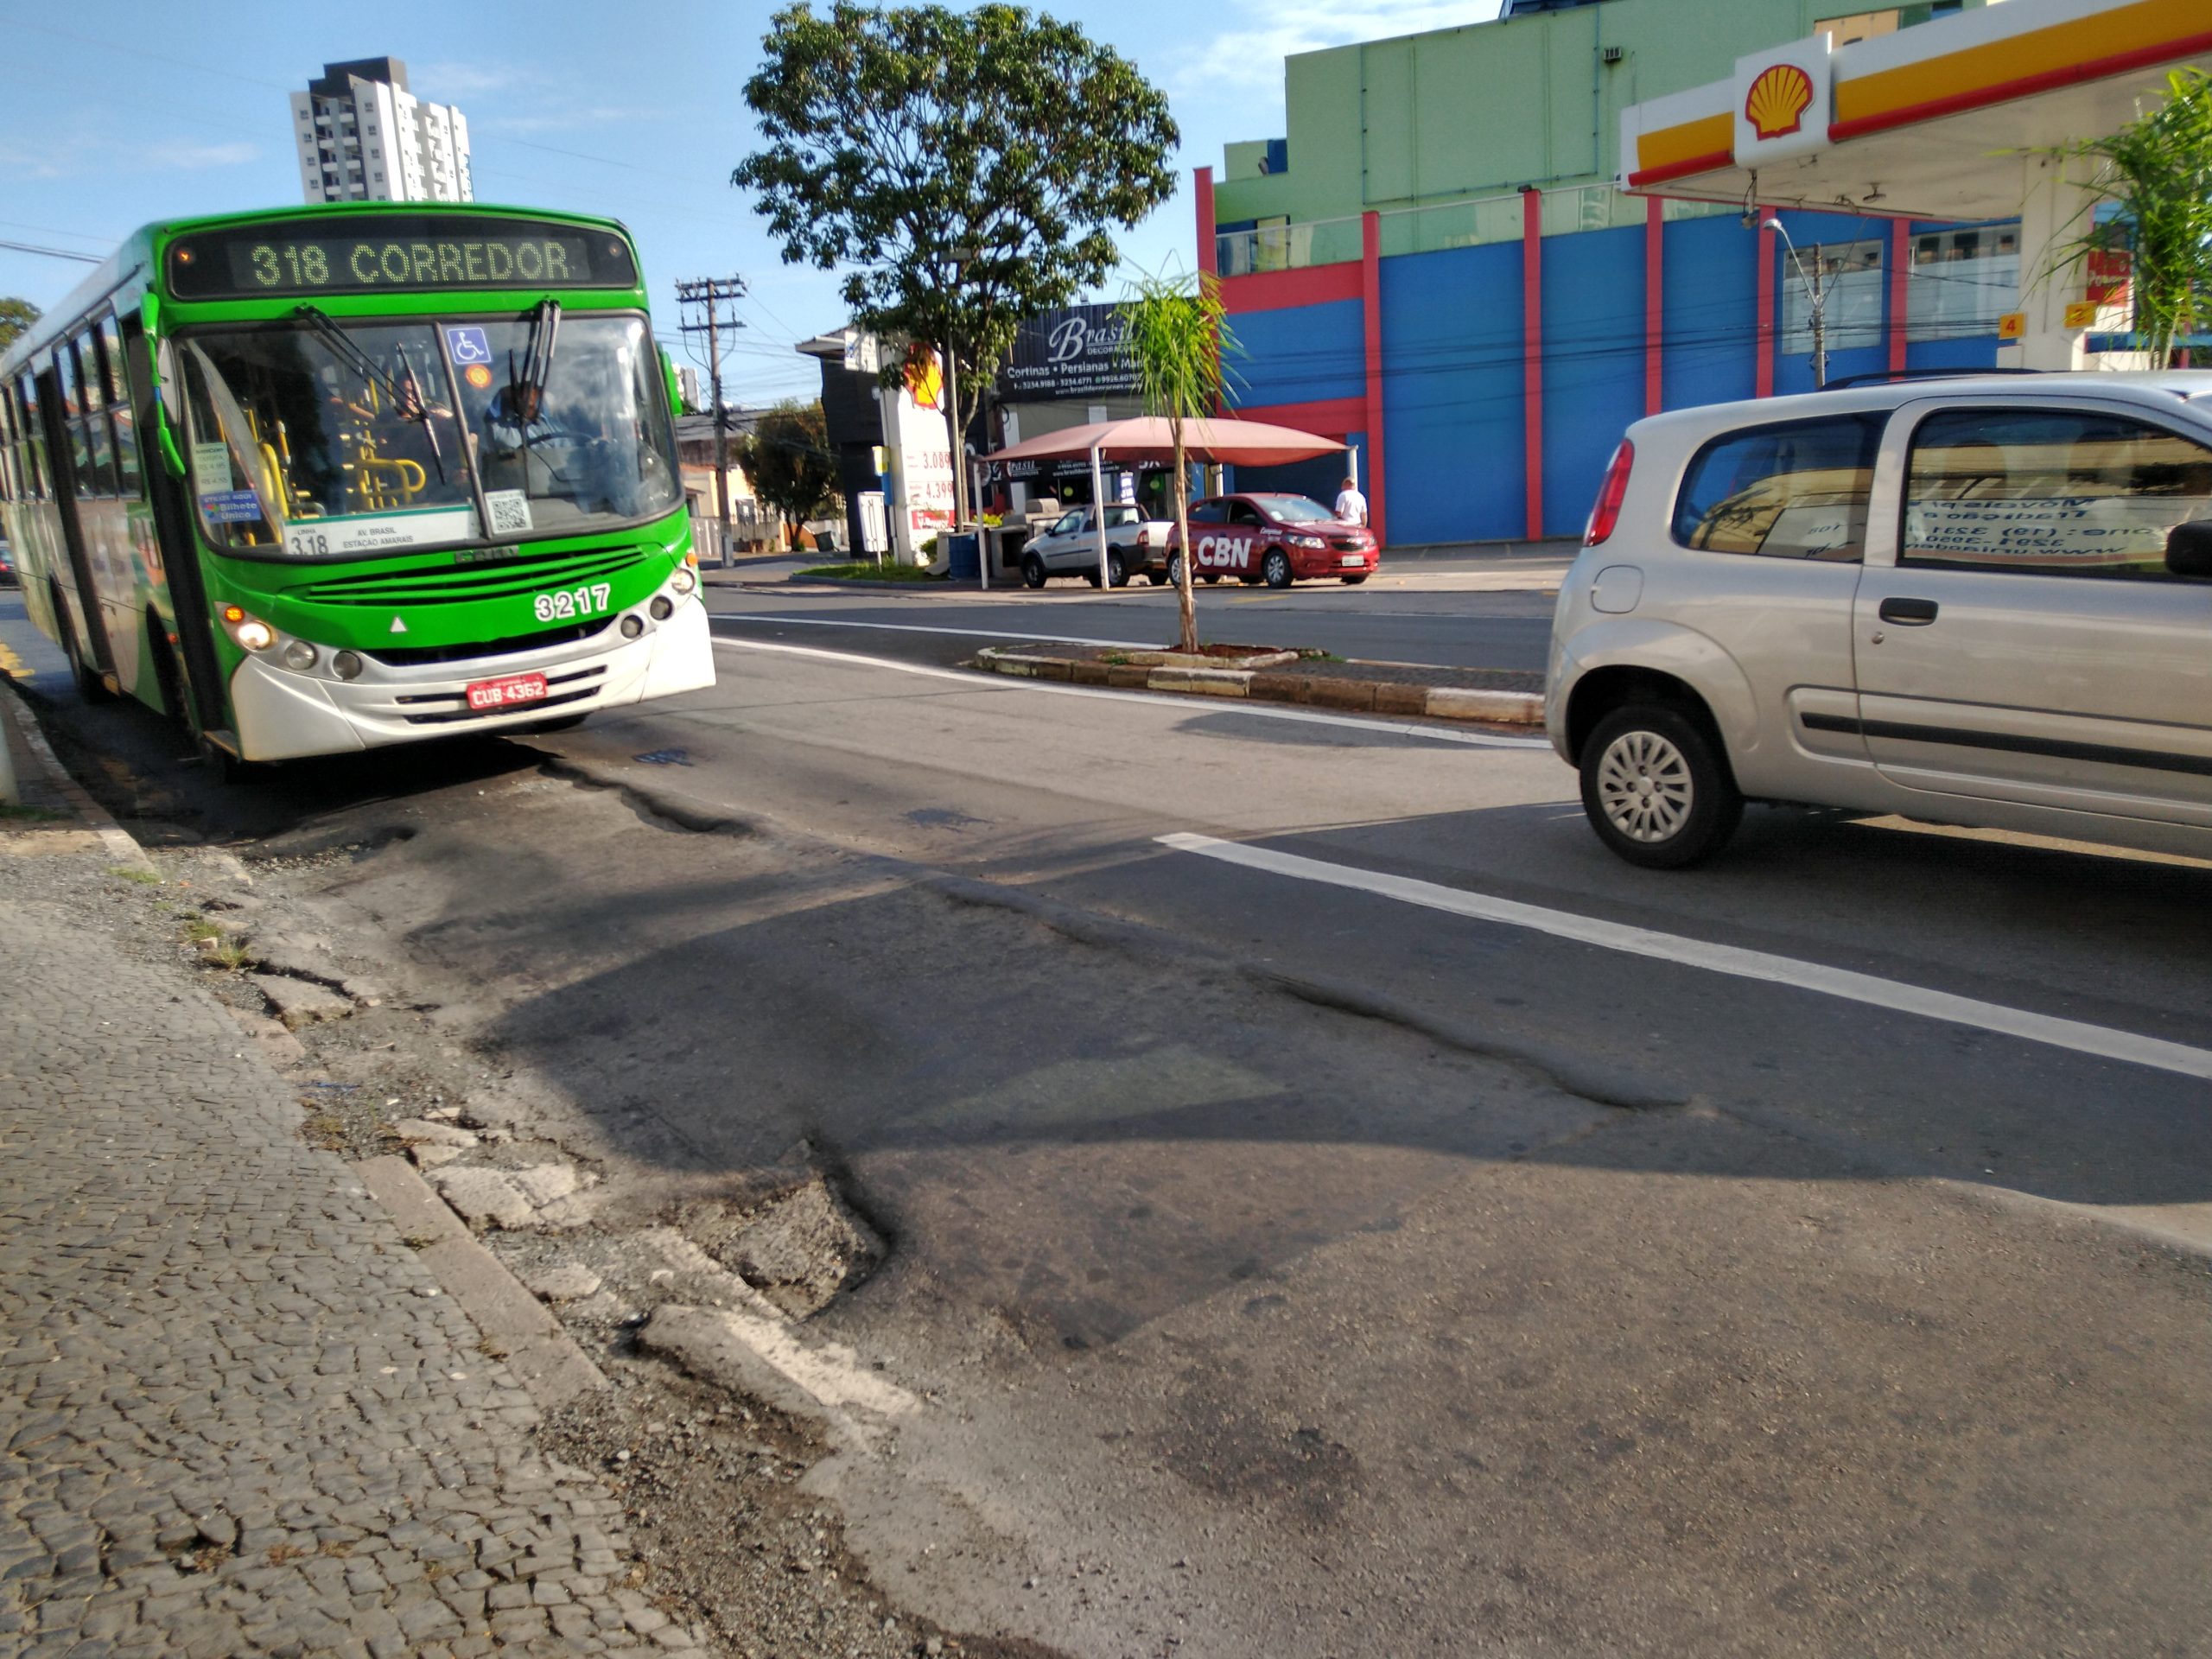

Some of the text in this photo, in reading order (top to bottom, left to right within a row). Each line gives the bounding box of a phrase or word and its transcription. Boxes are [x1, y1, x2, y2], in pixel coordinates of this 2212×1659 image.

[251, 241, 569, 286] 318 CORREDOR
[2005, 318, 2016, 333] 4
[1047, 317, 1134, 363] Brasil
[1007, 365, 1050, 378] Cortinas
[1061, 360, 1109, 374] Persianas
[220, 503, 257, 512] Bilhete
[370, 526, 397, 536] BRASIL
[381, 535, 414, 545] AMARAIS
[1198, 536, 1252, 569] CBN
[534, 582, 611, 621] 3217
